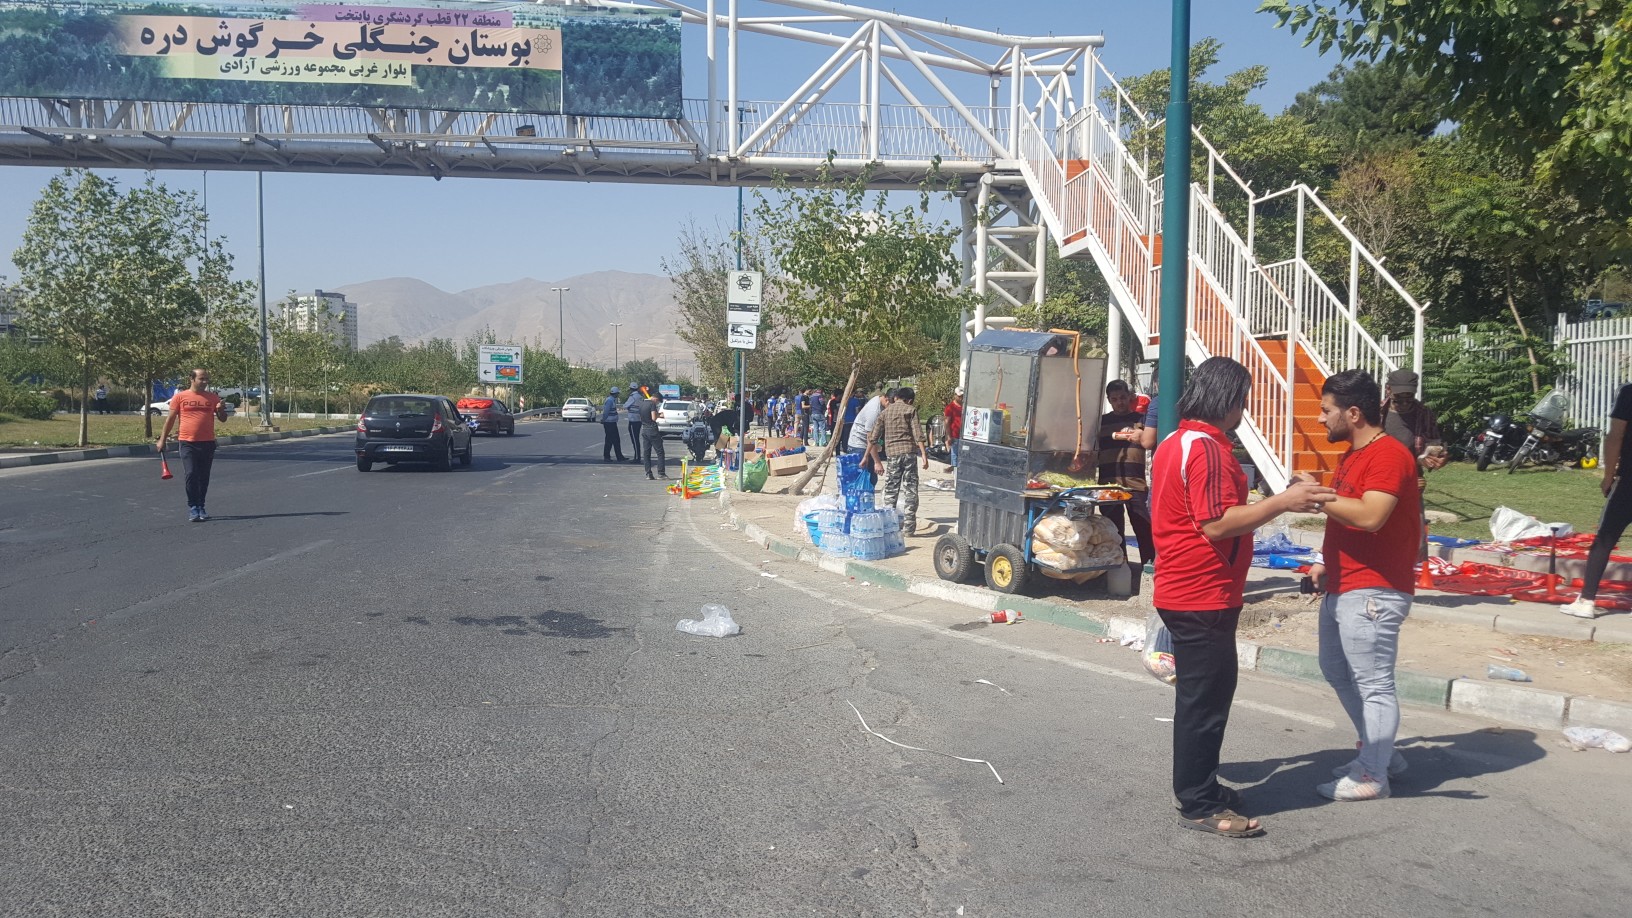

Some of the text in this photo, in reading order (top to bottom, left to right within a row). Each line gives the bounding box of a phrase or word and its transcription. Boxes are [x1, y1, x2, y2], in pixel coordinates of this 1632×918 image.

[335, 10, 501, 27] منطقه ۲۲ قطب گردشگری پایتخت
[140, 24, 188, 55] دره
[332, 24, 440, 63] جنگلی
[447, 28, 532, 66] بوستان
[219, 57, 407, 79] بلوار غربی مجموعه ورزشی آزادی
[183, 400, 212, 408] POLO
